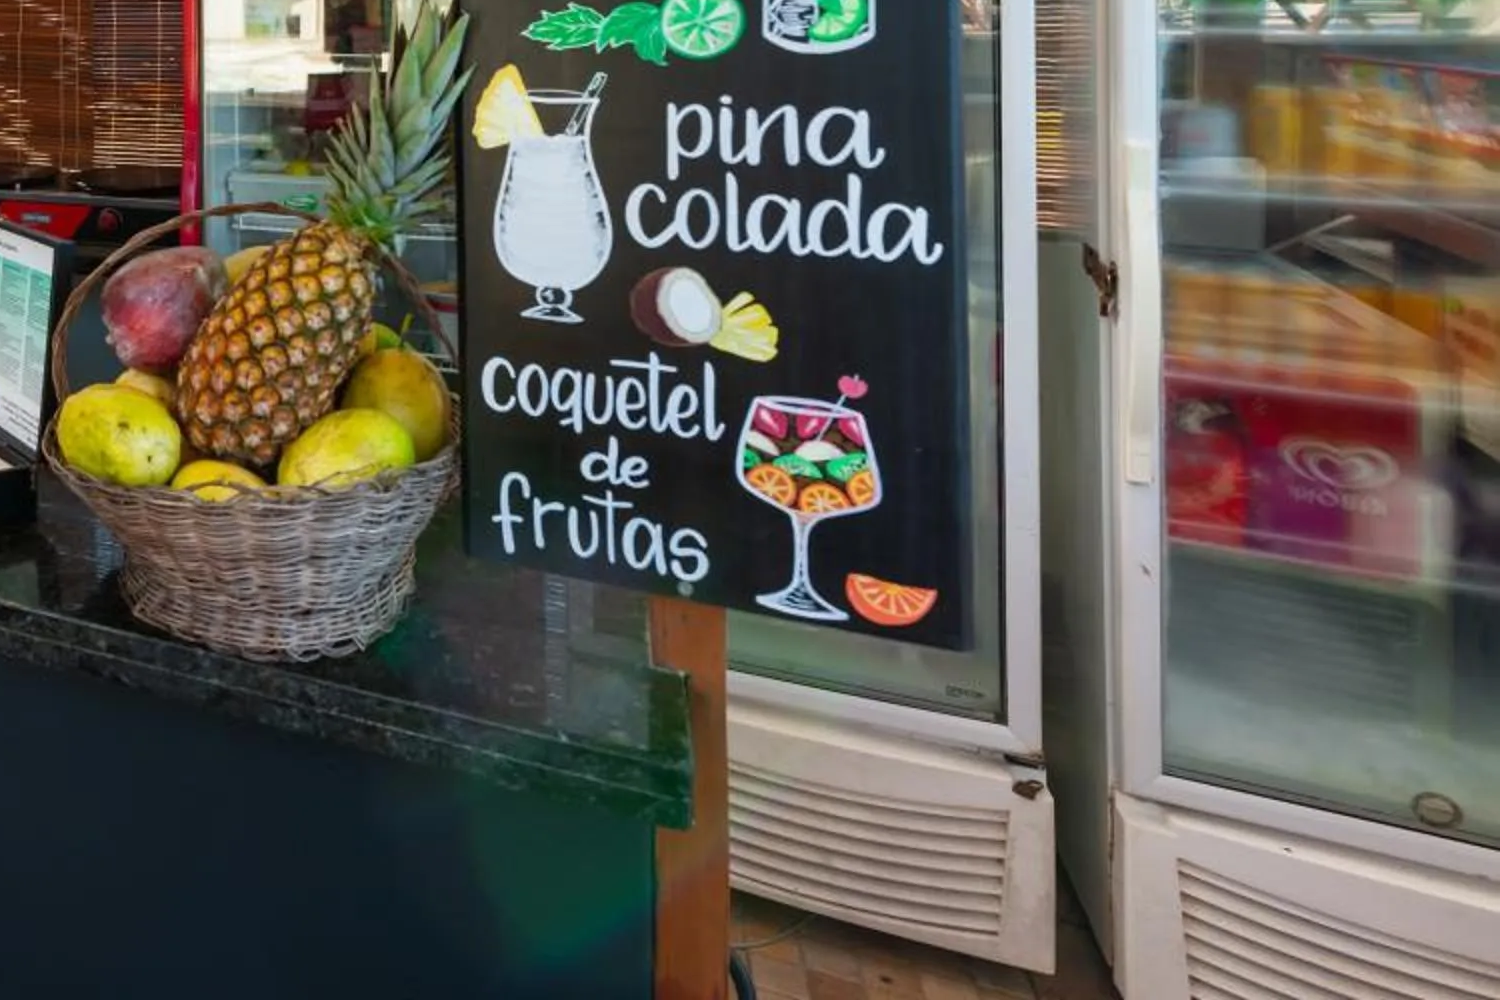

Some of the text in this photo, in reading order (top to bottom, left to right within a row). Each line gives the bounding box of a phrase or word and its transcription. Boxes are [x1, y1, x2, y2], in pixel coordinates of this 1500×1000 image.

[666, 94, 886, 181] pina
[624, 172, 944, 266] colada
[481, 351, 726, 442] coquetel
[580, 435, 652, 488] de
[491, 471, 711, 582] frutas
